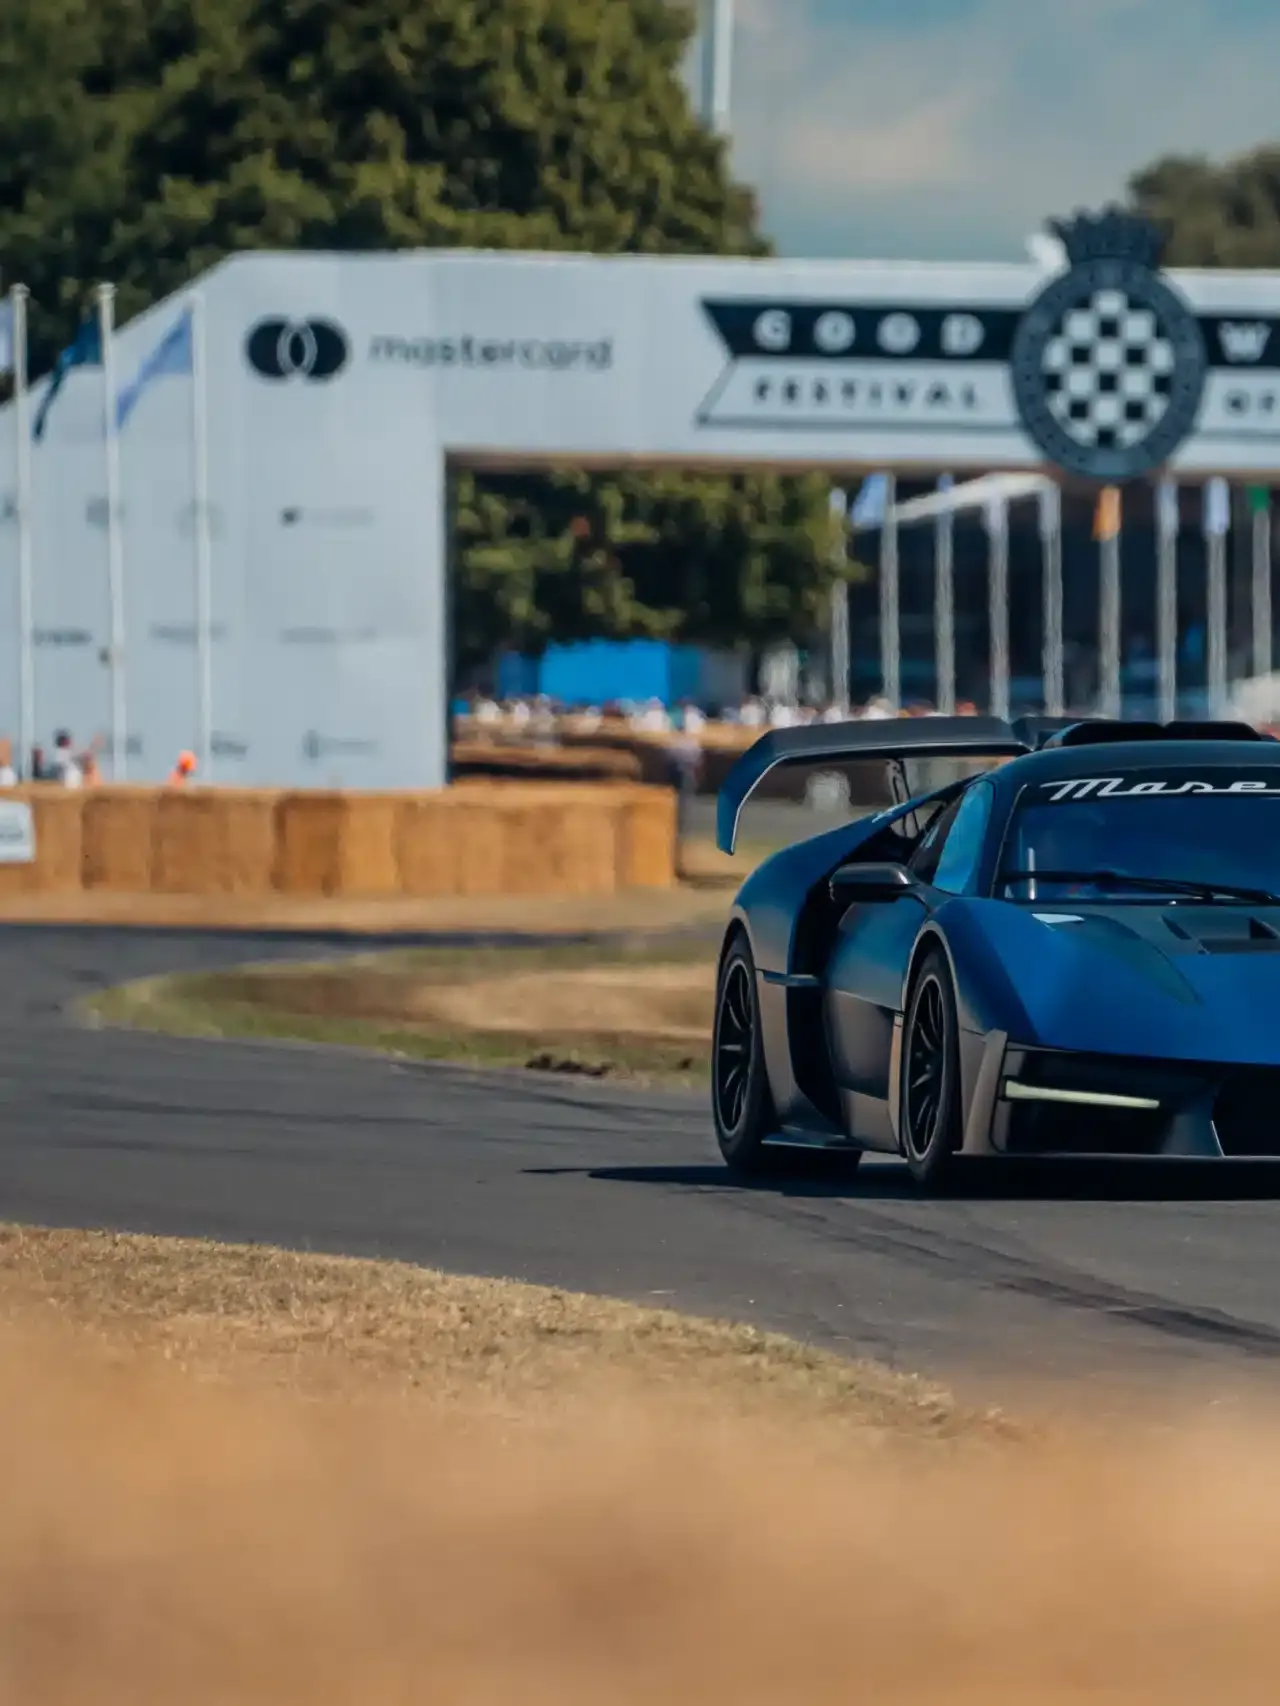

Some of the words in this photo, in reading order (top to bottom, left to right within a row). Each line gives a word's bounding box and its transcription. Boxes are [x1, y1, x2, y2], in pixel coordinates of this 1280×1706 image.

[368, 333, 615, 372] mastercard
[752, 307, 985, 356] GOOD
[752, 375, 977, 410] FESTIVAL
[1222, 387, 1277, 419] OF
